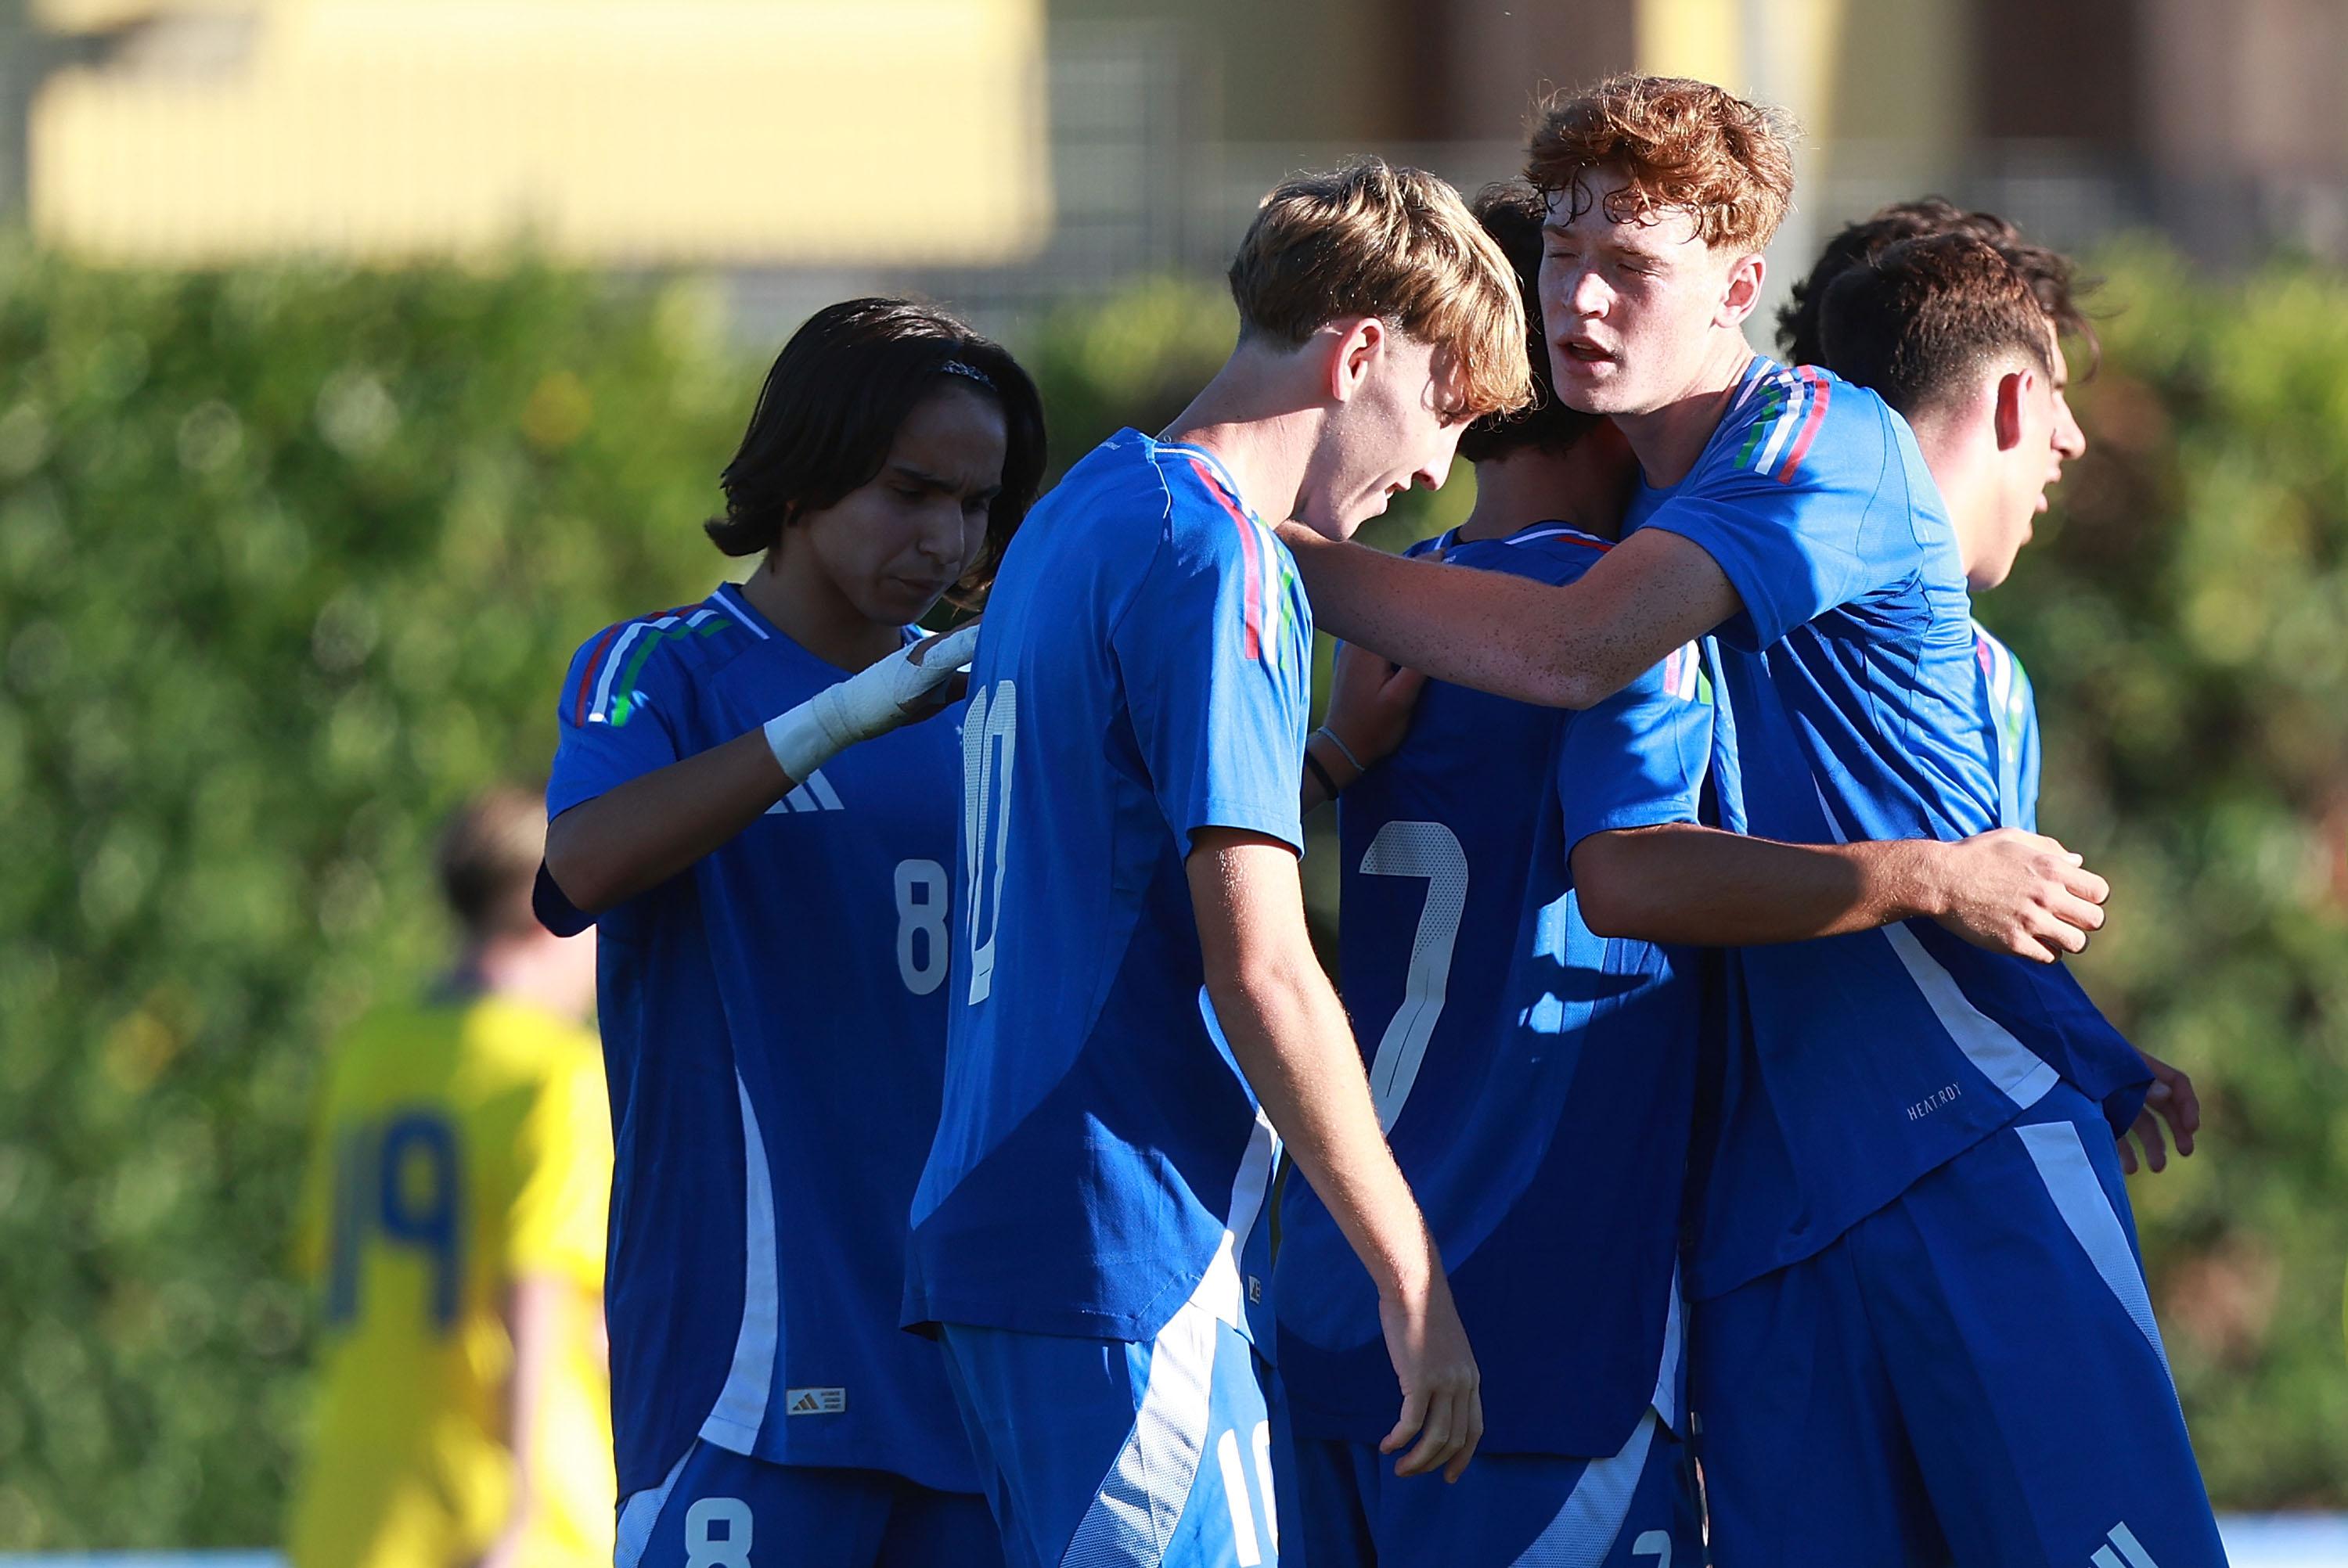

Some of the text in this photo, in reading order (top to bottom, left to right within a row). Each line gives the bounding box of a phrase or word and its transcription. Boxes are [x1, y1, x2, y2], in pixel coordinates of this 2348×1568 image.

[894, 858, 949, 995] 8
[1359, 820, 1469, 1138] 7
[325, 1109, 463, 1332] 19
